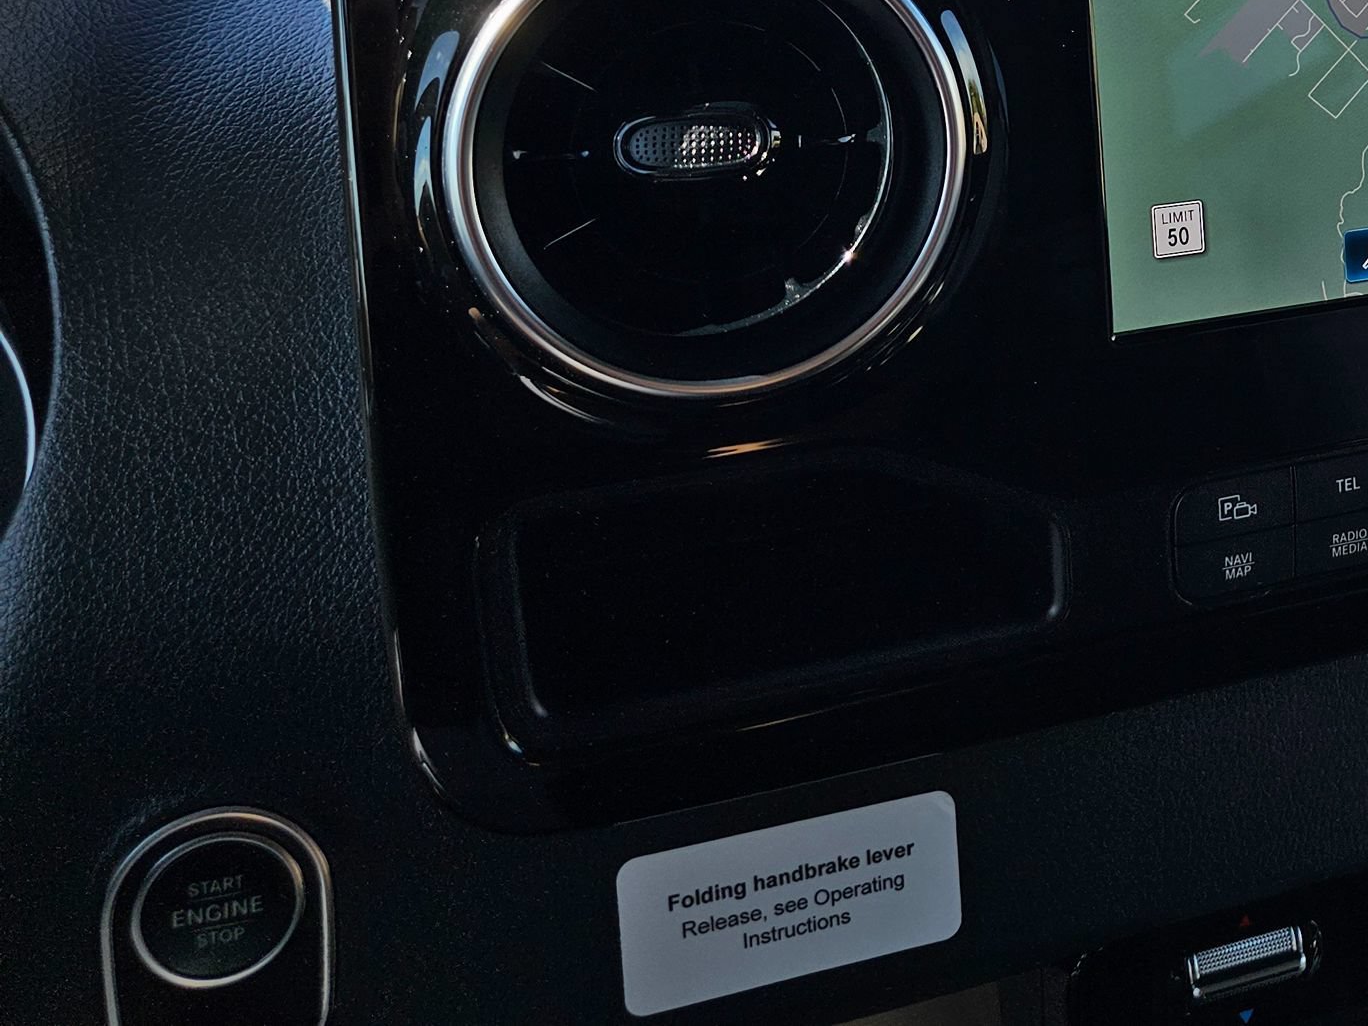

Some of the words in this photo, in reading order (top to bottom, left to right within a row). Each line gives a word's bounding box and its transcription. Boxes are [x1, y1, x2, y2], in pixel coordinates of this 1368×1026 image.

[1161, 209, 1195, 225] LIMIT
[1168, 226, 1190, 247] 50
[1335, 476, 1361, 494] TEL
[1332, 528, 1368, 545] RADIO
[1331, 541, 1368, 558] MEDIA
[1224, 552, 1253, 568] NAVI
[1225, 565, 1252, 581] MAP
[189, 875, 243, 896] START
[667, 880, 747, 912] Folding
[753, 854, 861, 892] handbrake
[866, 842, 915, 866] lever
[172, 895, 264, 928] ENGINE
[682, 907, 768, 939] Release,
[773, 896, 809, 916] see
[814, 873, 906, 907] Operating
[197, 927, 246, 947] STOP
[743, 910, 852, 949] Instructions
